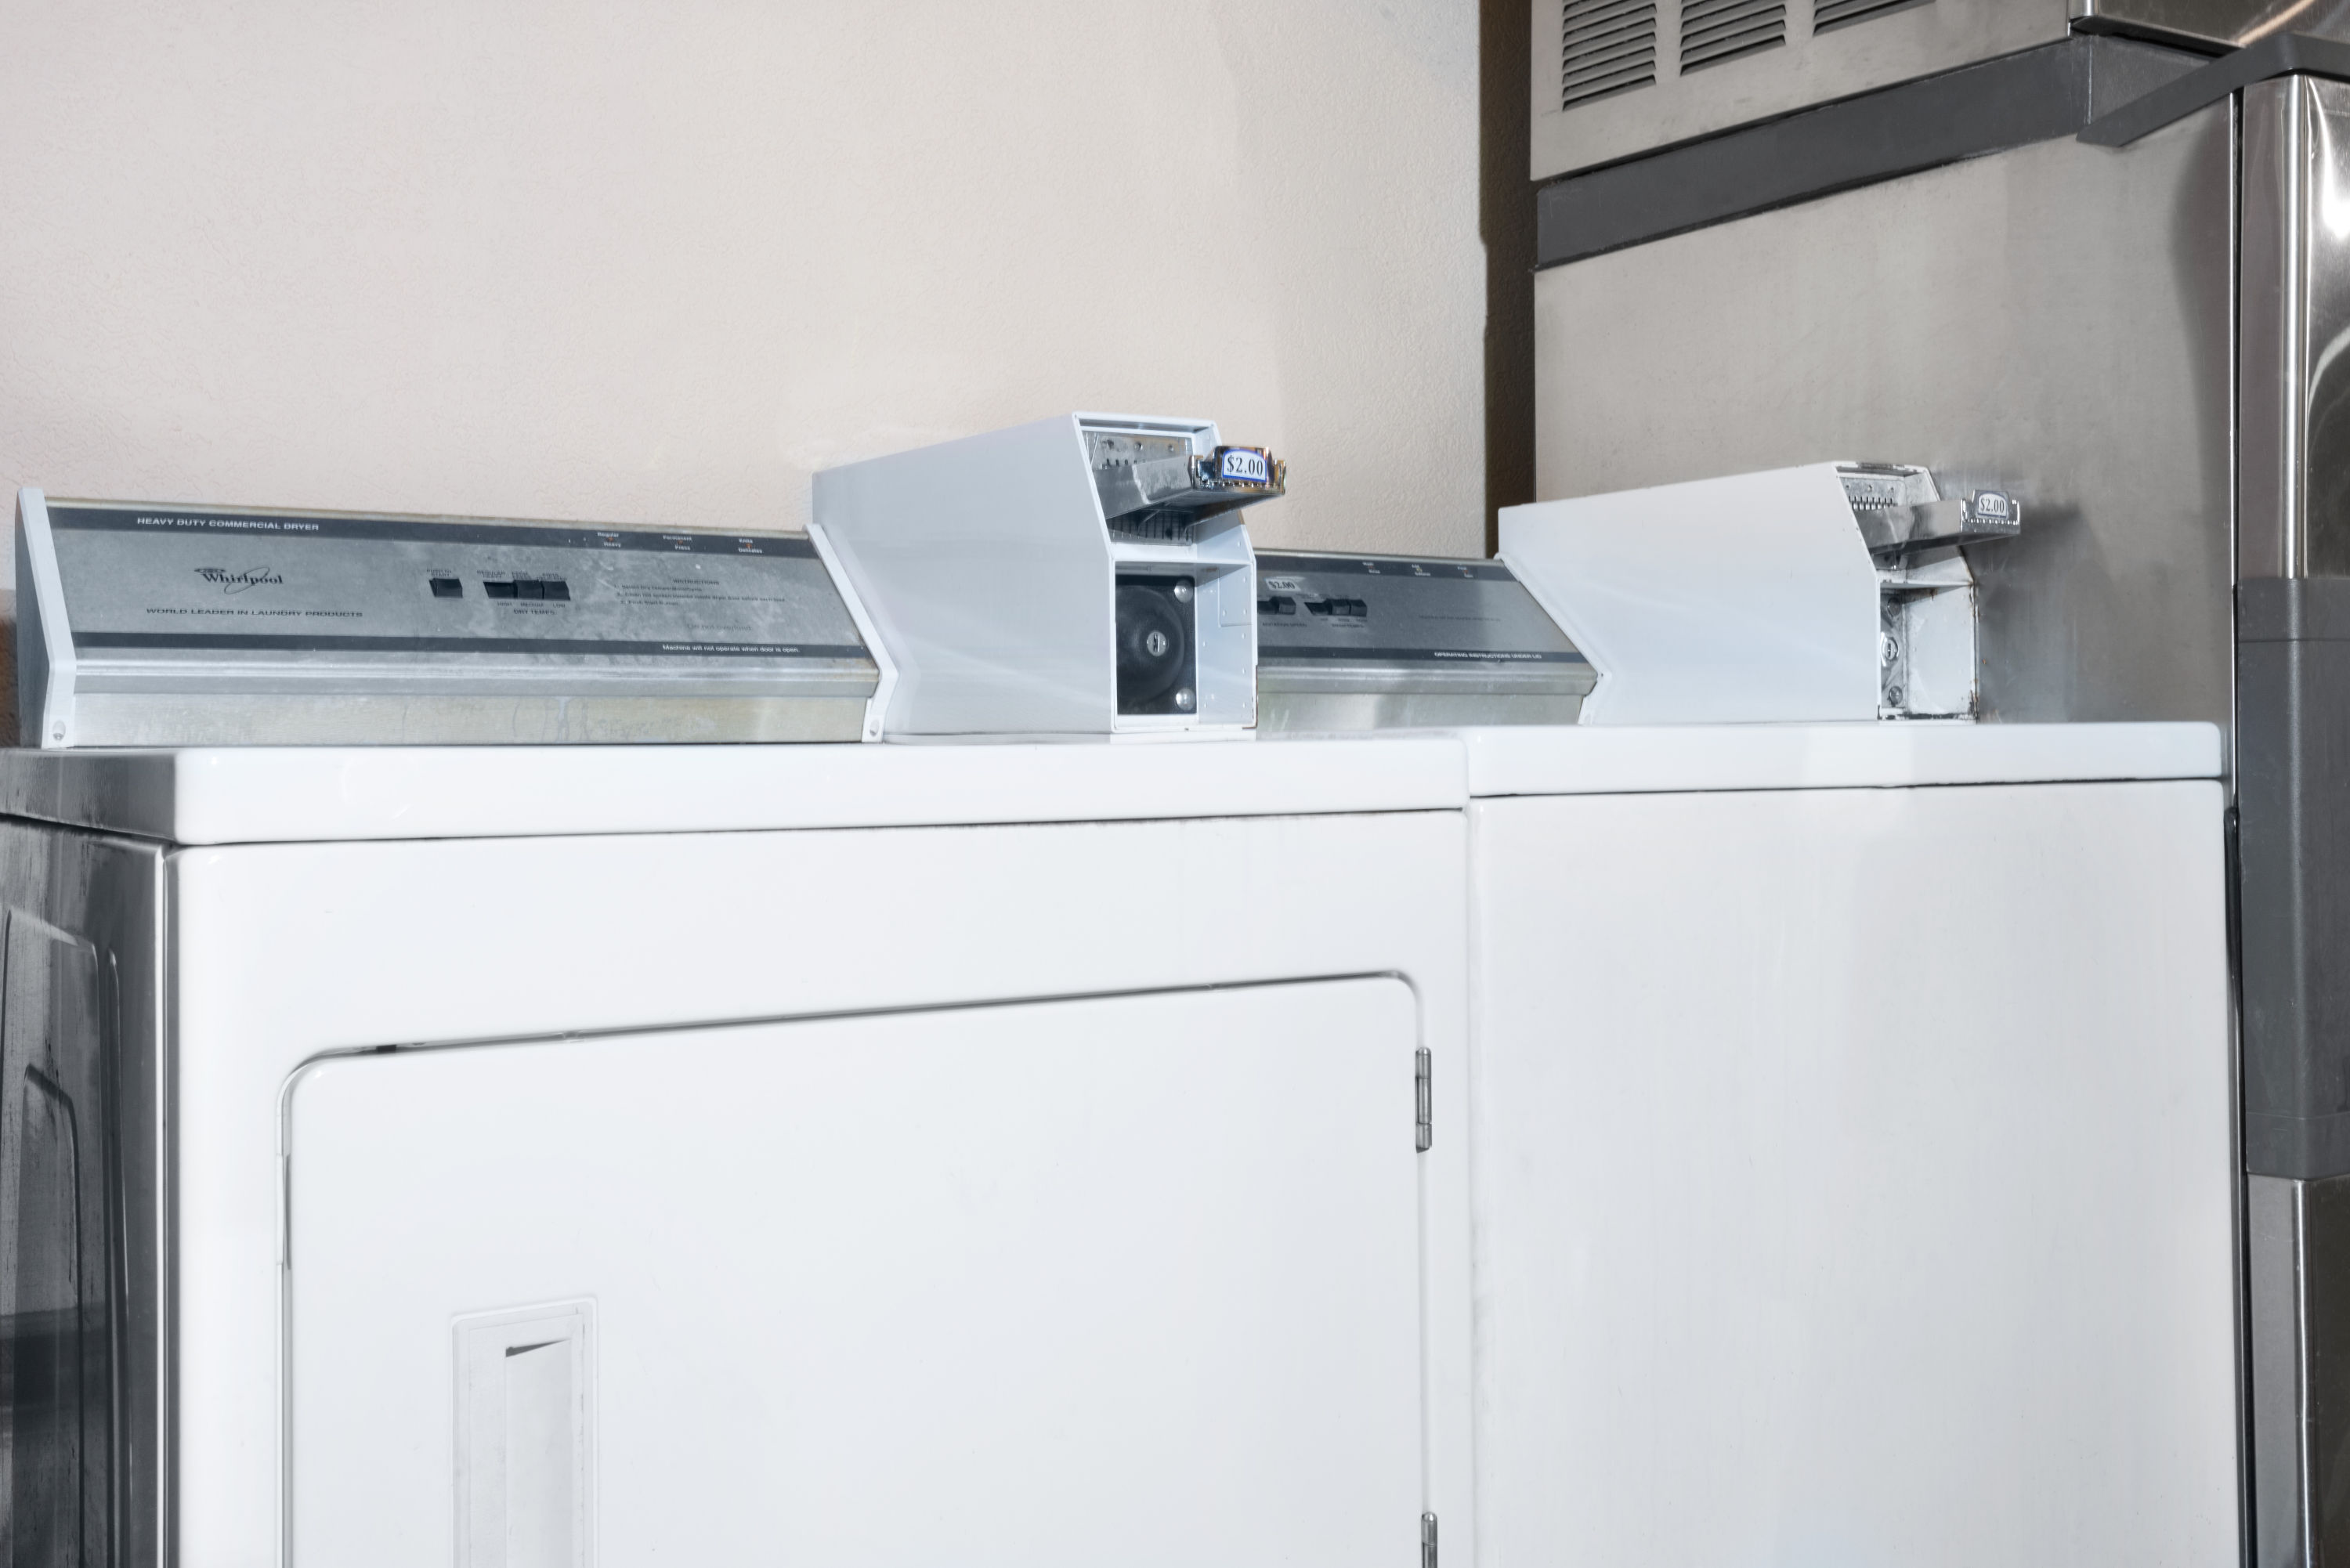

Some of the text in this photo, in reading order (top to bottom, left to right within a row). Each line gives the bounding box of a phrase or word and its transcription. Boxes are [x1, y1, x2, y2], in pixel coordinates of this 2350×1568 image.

[1227, 454, 1264, 476] $2.00
[1980, 497, 2005, 513] $2.00
[137, 517, 174, 526] HEAVY
[208, 519, 281, 529] COMMERCIAL
[284, 522, 319, 531] DRYER
[201, 569, 284, 588] Whirlpool
[1268, 580, 1296, 590] $2.00
